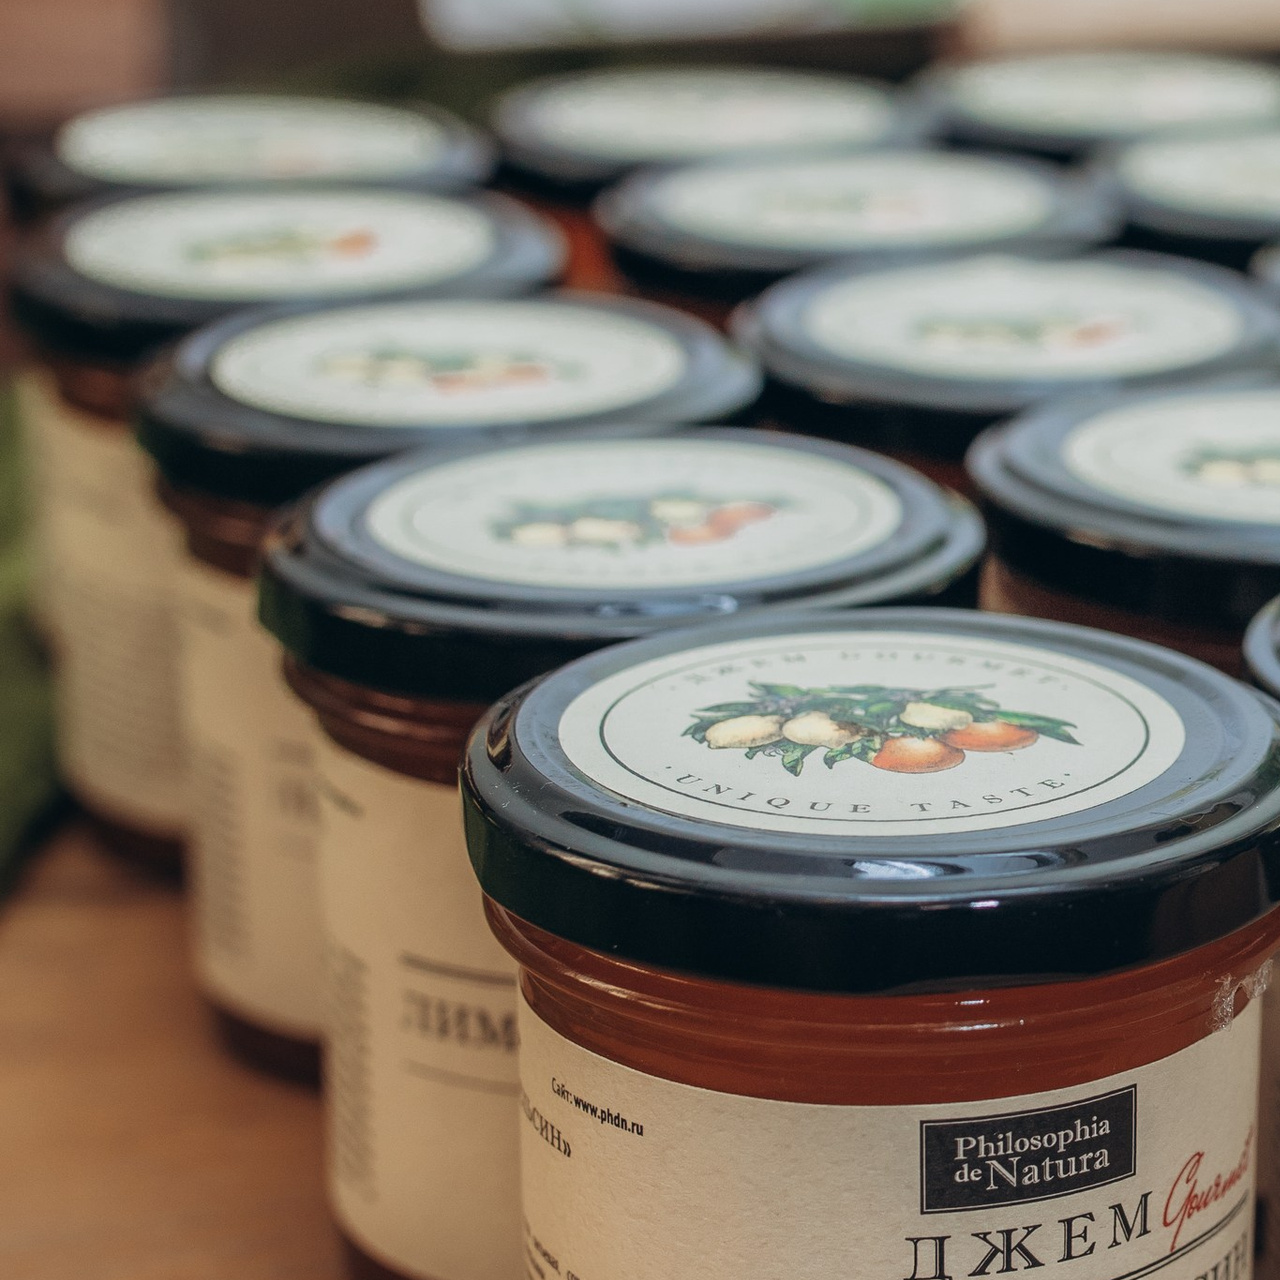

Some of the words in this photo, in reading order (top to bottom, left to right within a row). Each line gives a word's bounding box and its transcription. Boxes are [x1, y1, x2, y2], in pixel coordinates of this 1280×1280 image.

[675, 770, 873, 815] UNIQUE
[916, 776, 1066, 814] TASTE
[551, 1076, 574, 1105] Сайт:
[572, 1093, 645, 1137] www.phdn.ru
[954, 1115, 1112, 1161] Philosophia
[954, 1162, 983, 1183] de
[985, 1145, 1111, 1191] Natura
